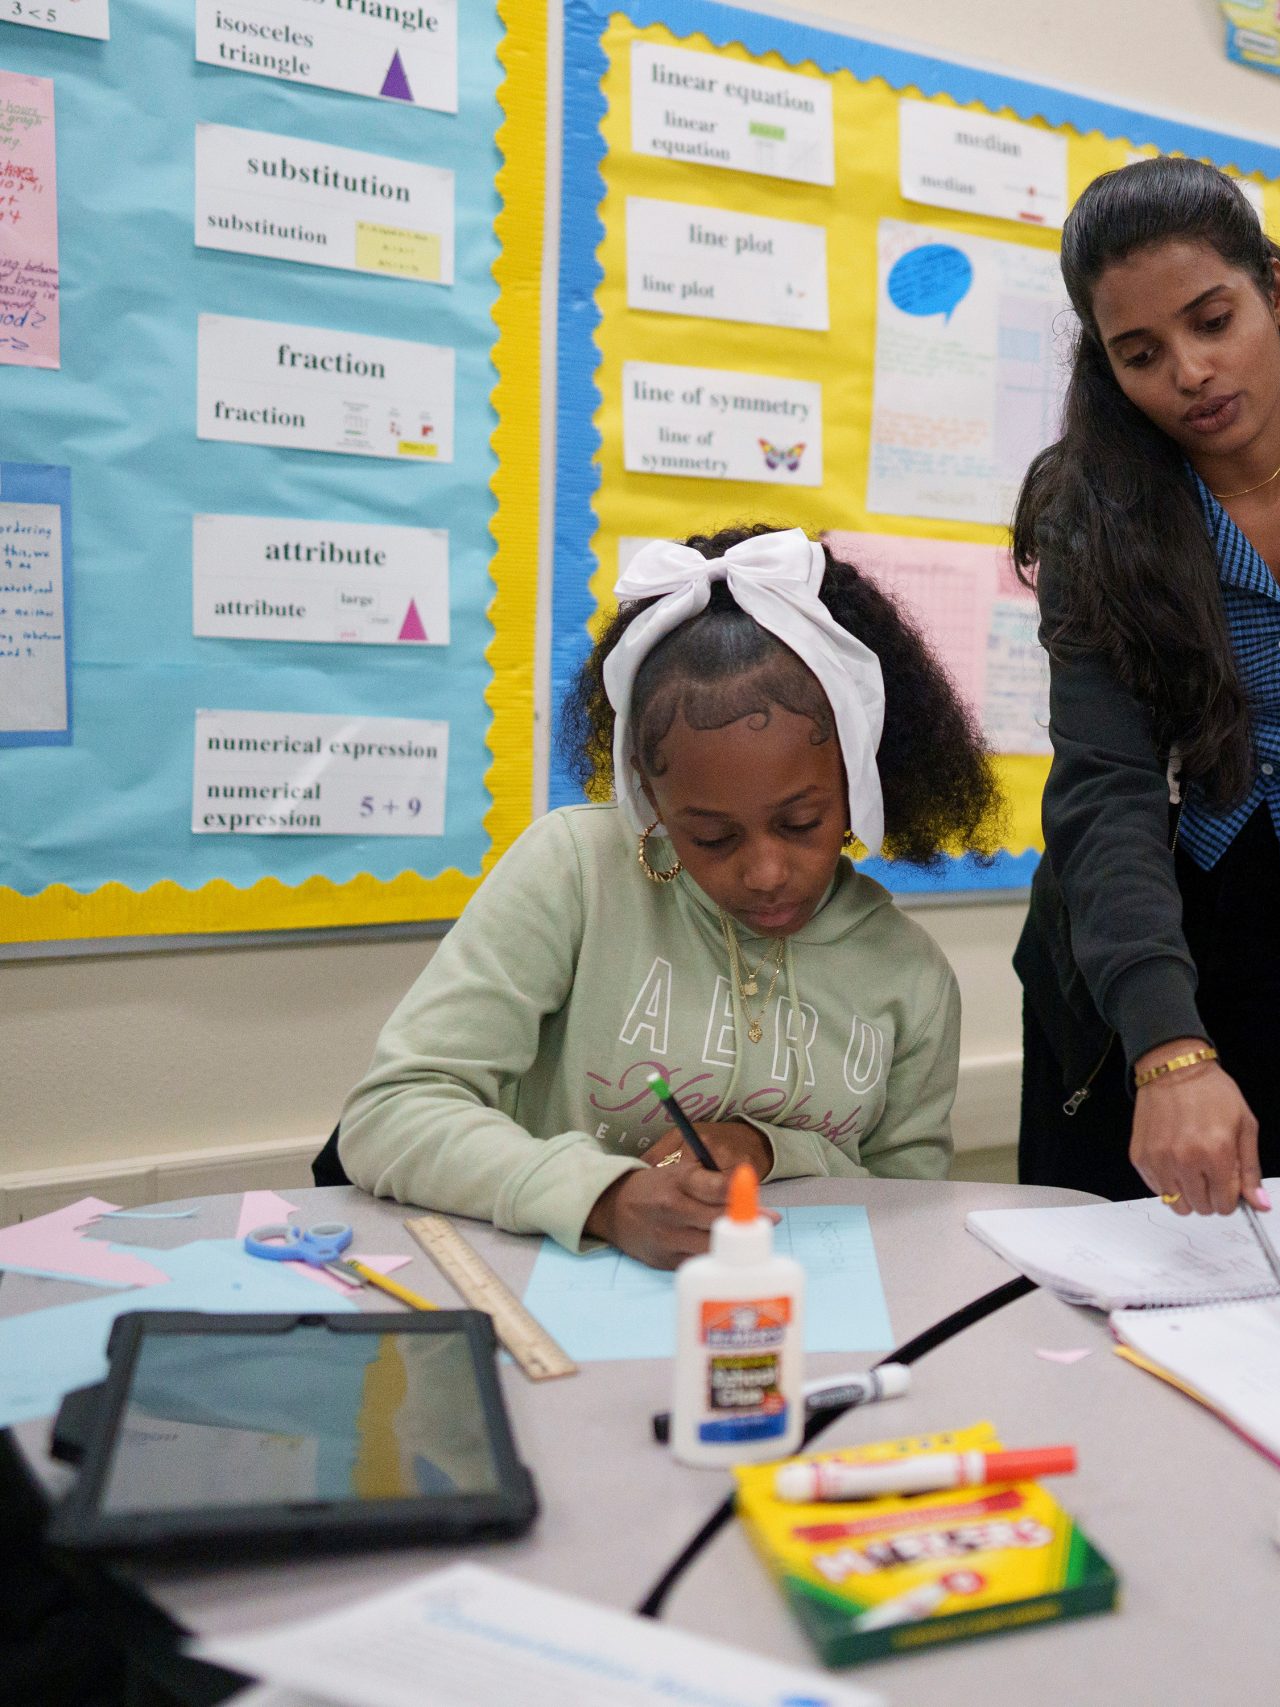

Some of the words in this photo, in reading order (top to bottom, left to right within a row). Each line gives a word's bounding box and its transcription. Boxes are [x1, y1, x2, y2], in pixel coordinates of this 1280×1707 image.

[11, 1, 22, 16] 3
[28, 9, 42, 20] <
[47, 8, 57, 22] 5
[333, 0, 440, 33] triangle
[214, 10, 314, 48] isosceles
[218, 41, 311, 76] triangle
[650, 63, 719, 94] linear
[724, 81, 816, 115] equation
[663, 109, 719, 134] linear
[651, 137, 731, 162] equation
[247, 156, 411, 203] substitution
[206, 213, 328, 246] substitution
[688, 223, 729, 248] line
[734, 234, 775, 257] plot
[641, 274, 676, 294] line
[680, 281, 716, 300] plot
[276, 343, 387, 380] fraction
[213, 399, 307, 429] fraction
[633, 380, 675, 403] line
[681, 386, 705, 406] of
[709, 393, 810, 422] symmetry
[658, 426, 691, 445] line
[696, 430, 714, 447] of
[641, 453, 730, 476] symmetry
[264, 540, 387, 567] attribute
[214, 598, 307, 619] attribute
[340, 591, 374, 608] large
[207, 734, 322, 754] numerical
[328, 740, 439, 761] expression
[206, 782, 322, 800] numerical
[202, 808, 322, 831] expression
[358, 795, 375, 818] 5
[383, 800, 400, 816] +
[407, 797, 422, 818] 9
